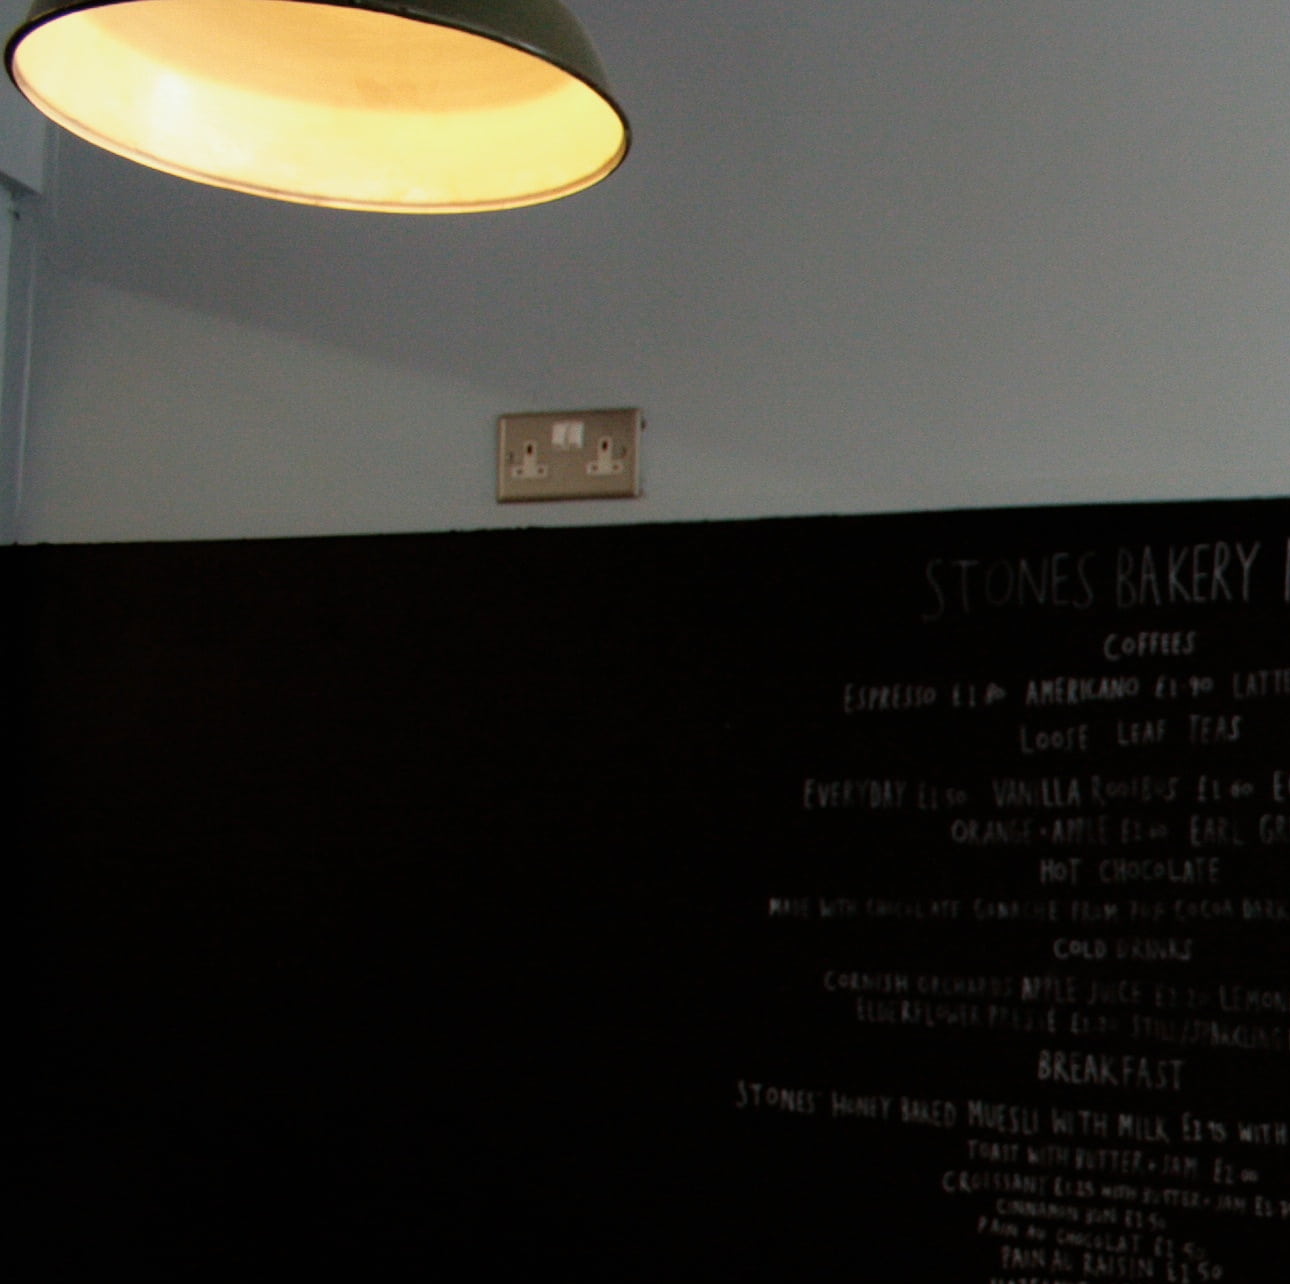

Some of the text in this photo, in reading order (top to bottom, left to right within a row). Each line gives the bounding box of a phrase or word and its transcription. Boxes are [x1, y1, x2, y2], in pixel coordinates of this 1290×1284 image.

[920, 550, 1097, 624] STONES
[1115, 540, 1262, 609] BAKERY
[1103, 630, 1198, 662] COFFEES
[842, 682, 938, 716] ESPRESSO
[1024, 674, 1141, 708] AMERICANO
[1018, 713, 1244, 757] LOOSE LEAF TEAS
[802, 776, 906, 811] EVERYDAY
[991, 776, 1082, 808] VANILLA
[1039, 855, 1222, 887] HOT CHOCOLATE
[1053, 936, 1107, 962] COLD
[1036, 1048, 1184, 1092] BREAKFAST
[967, 1098, 1041, 1137] MUESLI
[1050, 1105, 1111, 1140] WITH
[1117, 1110, 1172, 1146] MILK
[1237, 1117, 1289, 1148] WITH
[1082, 1251, 1155, 1281] RAISIN
